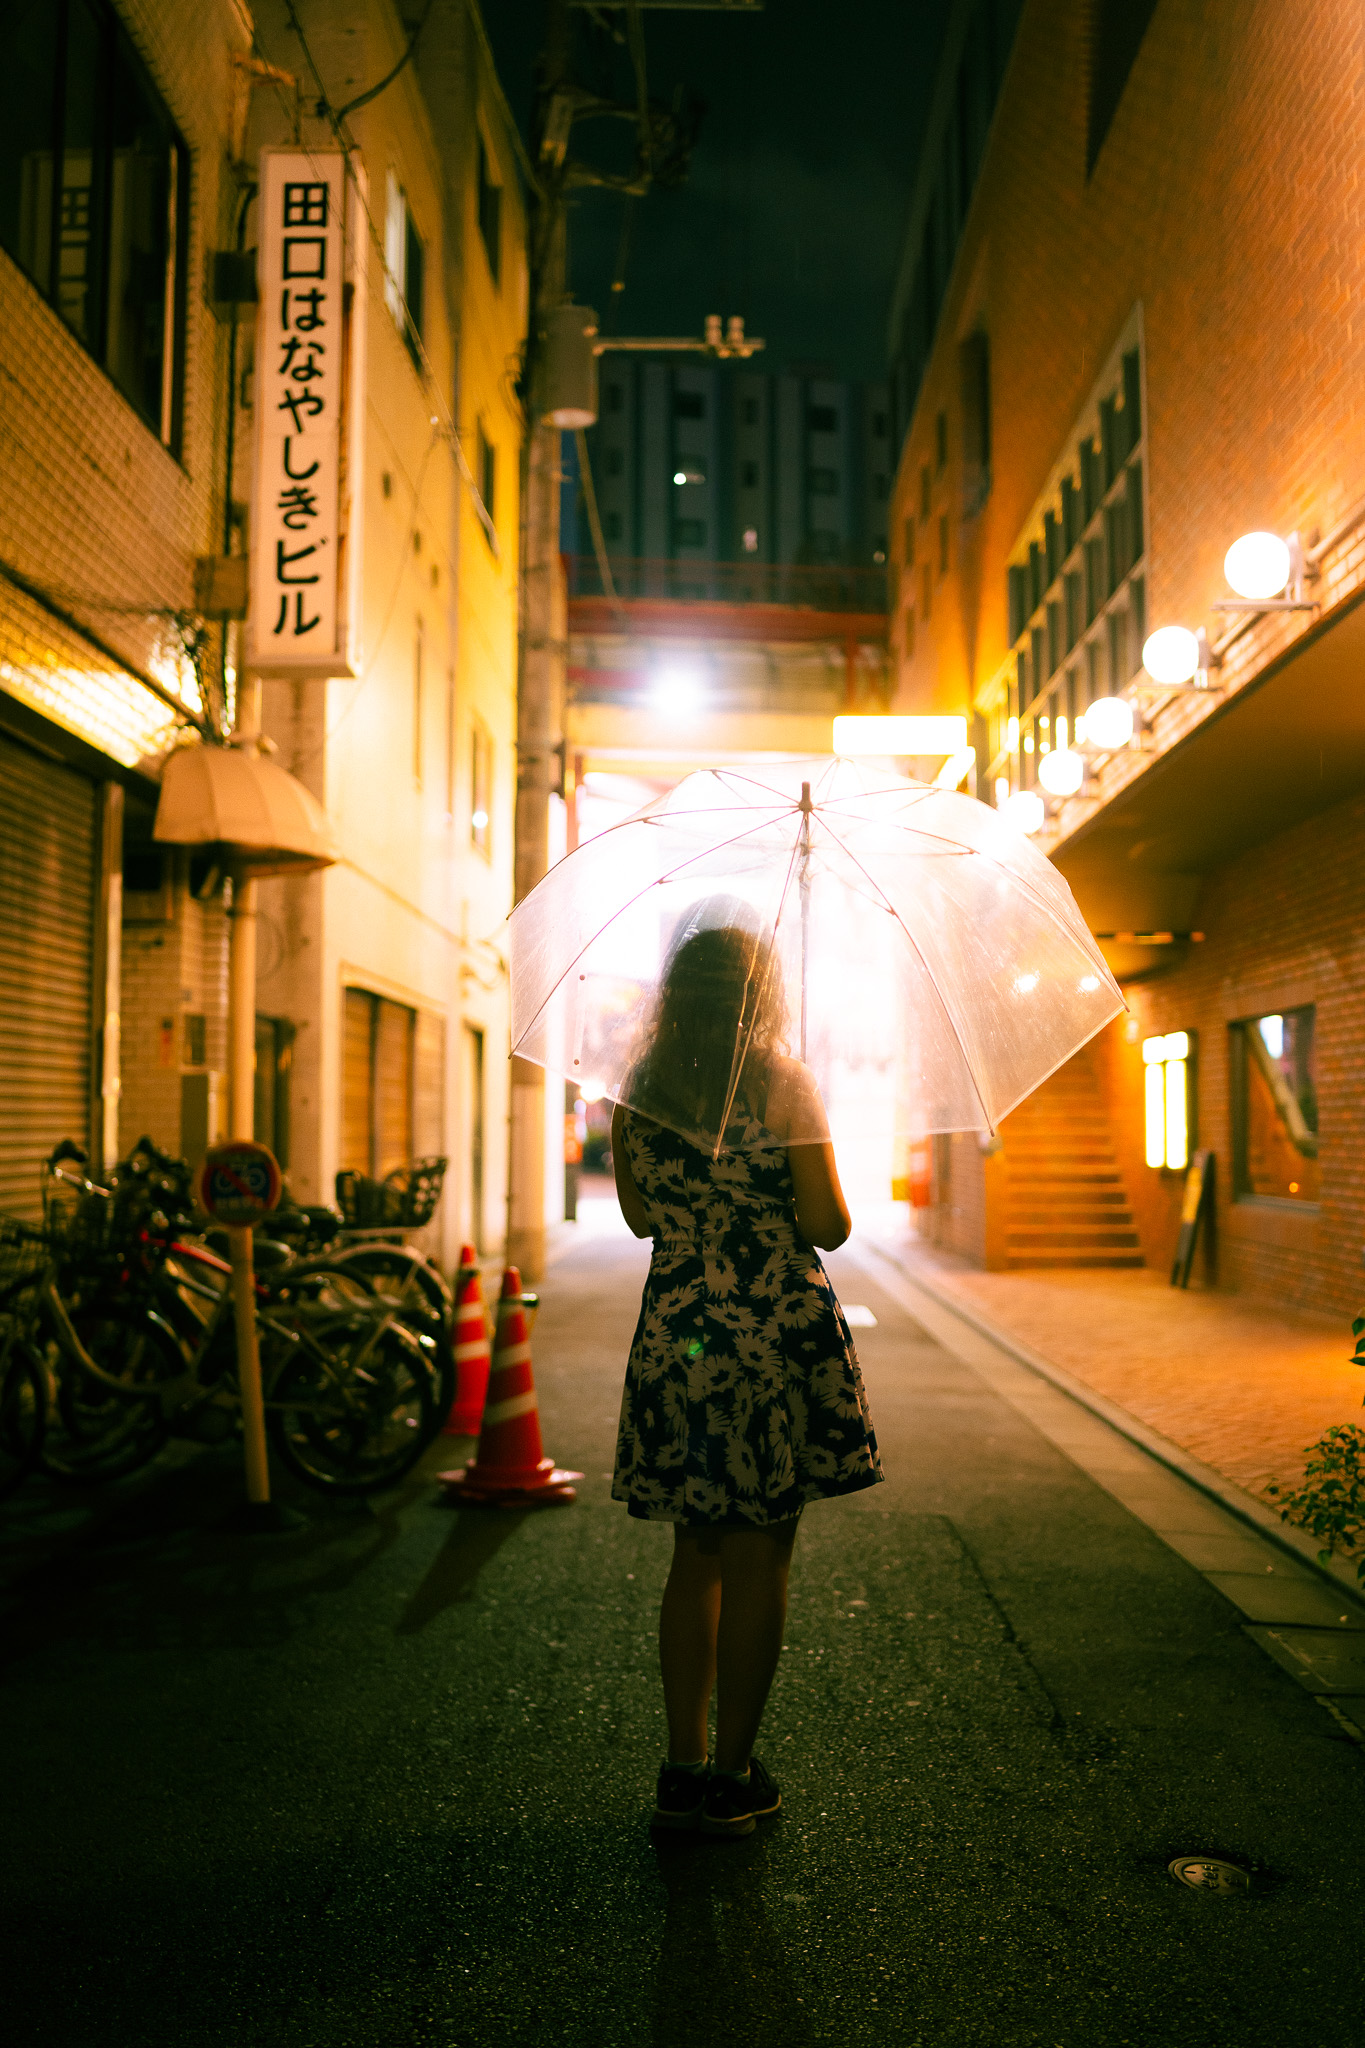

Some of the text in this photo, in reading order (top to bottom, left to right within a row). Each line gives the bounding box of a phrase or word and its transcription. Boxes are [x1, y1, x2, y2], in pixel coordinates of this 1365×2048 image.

[273, 181, 329, 637] 田口はなやしきビル
